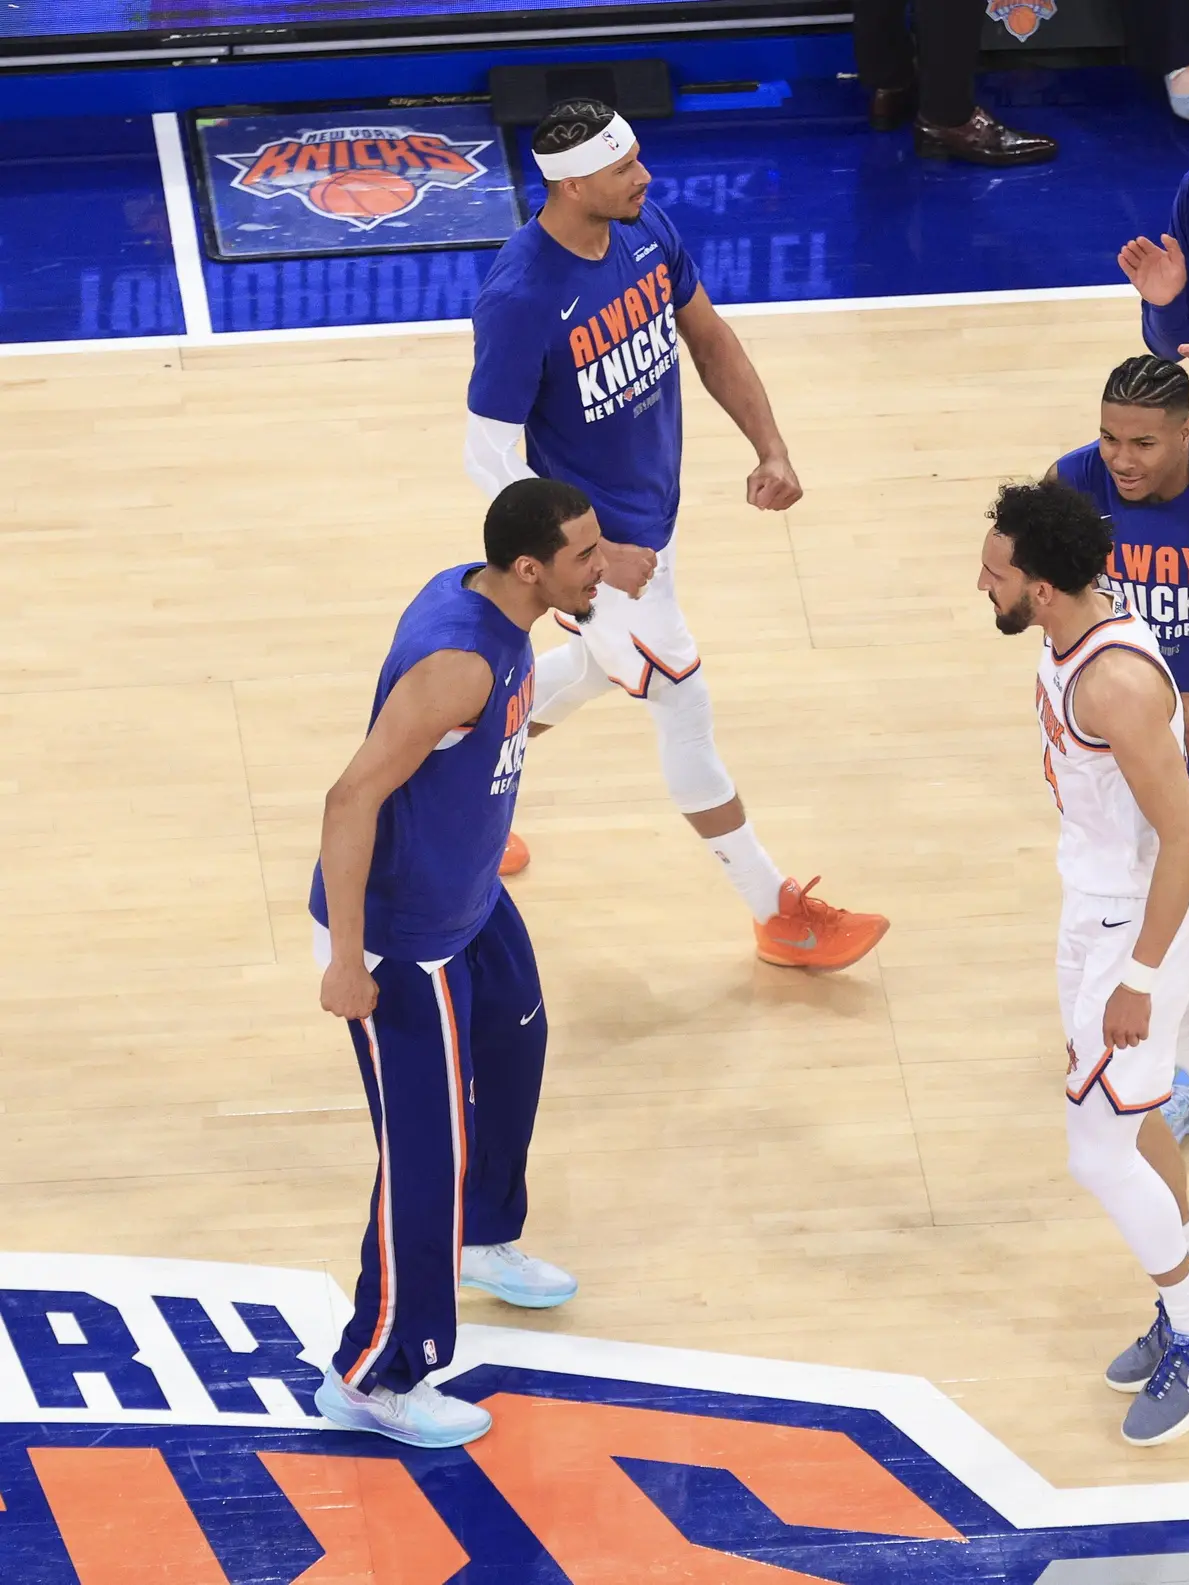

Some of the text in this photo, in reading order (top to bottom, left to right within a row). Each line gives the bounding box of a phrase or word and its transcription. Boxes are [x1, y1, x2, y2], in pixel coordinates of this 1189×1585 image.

[242, 135, 477, 186] KNICKS
[306, 127, 401, 143] NEW YORK
[569, 263, 672, 368] ALWAYS
[577, 302, 677, 408] KNICKS
[584, 398, 615, 424] NEW
[0, 1289, 325, 1418] RK
